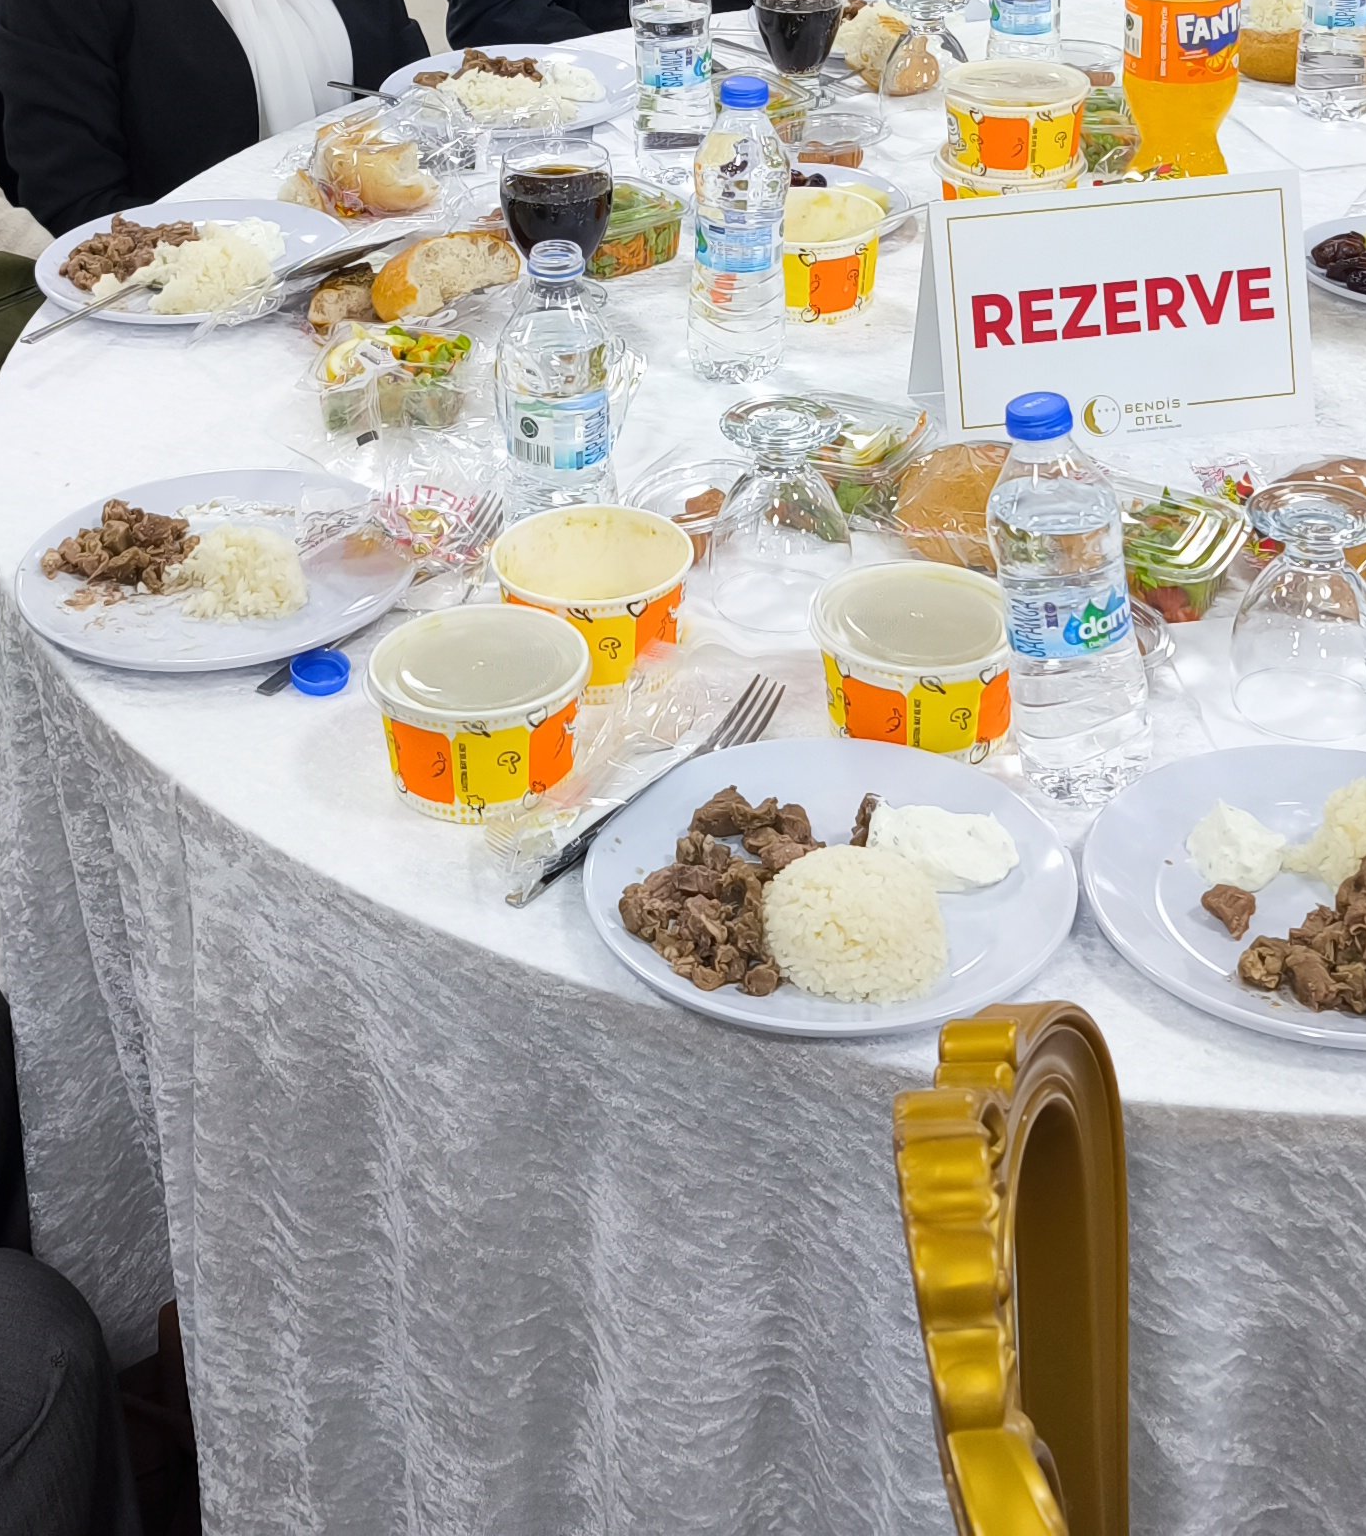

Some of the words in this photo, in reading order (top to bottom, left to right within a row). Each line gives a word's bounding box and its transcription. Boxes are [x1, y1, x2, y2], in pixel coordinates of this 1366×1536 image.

[970, 266, 1275, 349] REZERVE
[1124, 396, 1181, 414] BENDİS
[1135, 413, 1173, 426] OTEL
